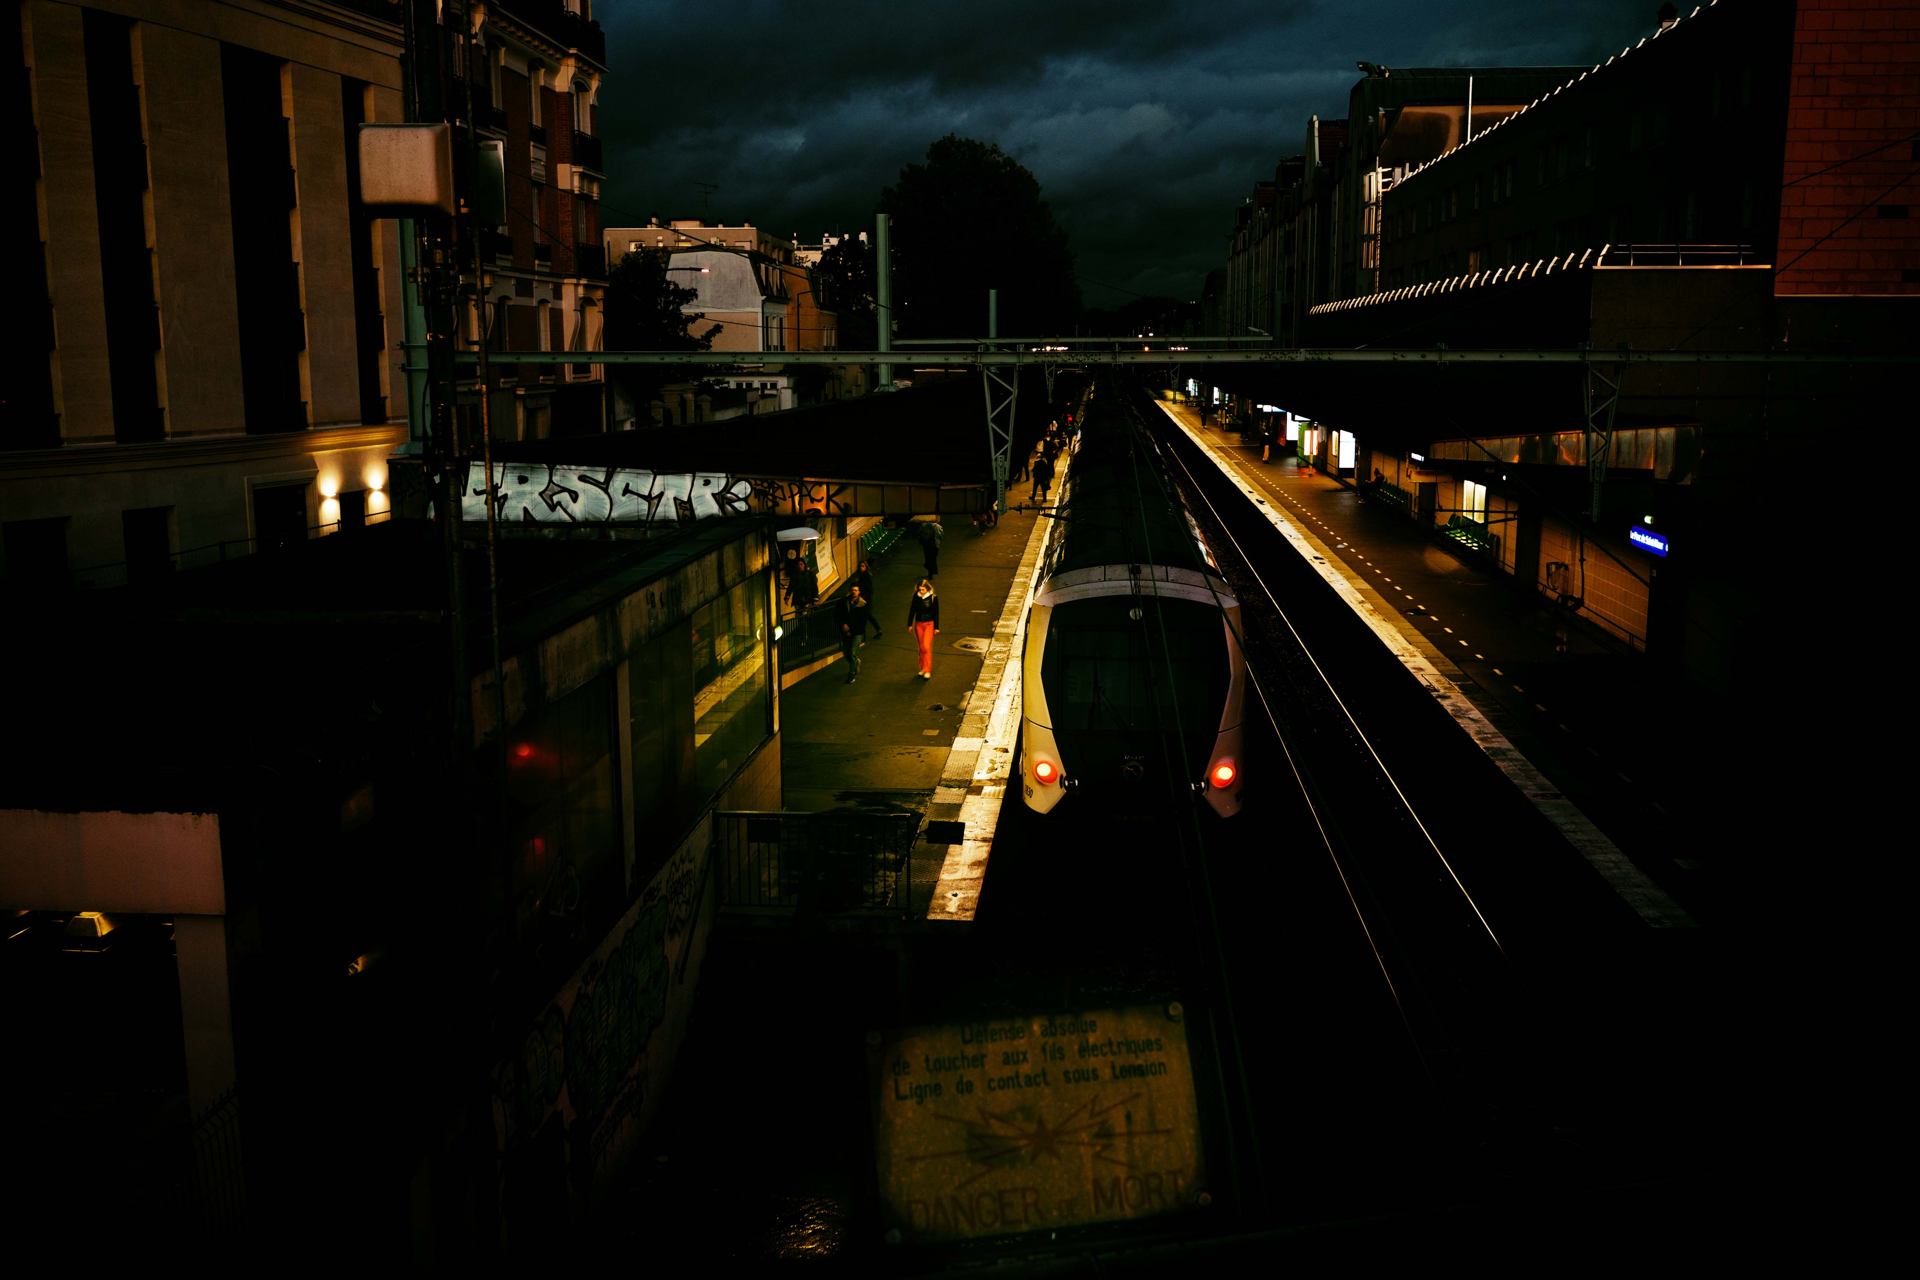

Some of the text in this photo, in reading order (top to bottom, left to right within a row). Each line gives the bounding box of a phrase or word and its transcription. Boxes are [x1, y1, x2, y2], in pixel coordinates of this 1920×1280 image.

[1040, 1016, 1098, 1038] absolue
[892, 1036, 1163, 1077] de toucher aux fils électriques
[894, 1059, 1168, 1106] Ligne de contact sous tension
[904, 1184, 1048, 1233] DANGER
[1091, 1167, 1184, 1214] MORT
